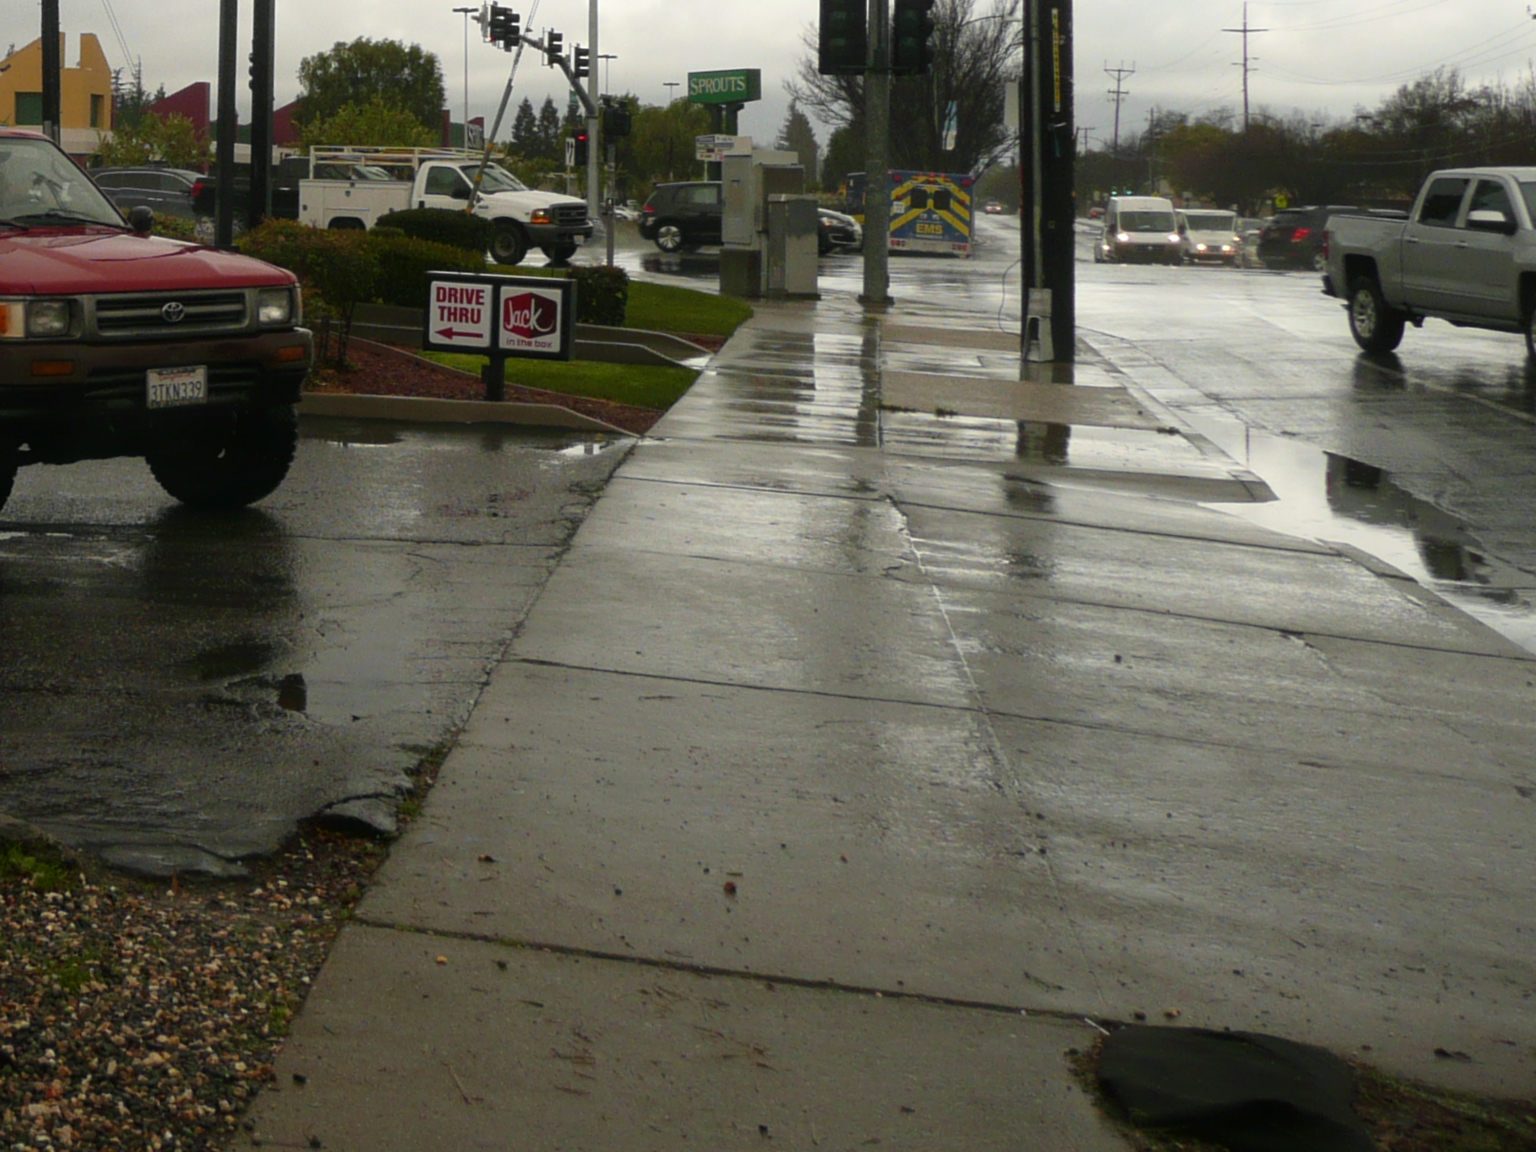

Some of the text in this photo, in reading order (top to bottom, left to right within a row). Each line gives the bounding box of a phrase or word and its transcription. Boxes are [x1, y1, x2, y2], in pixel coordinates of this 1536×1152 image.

[690, 75, 745, 96] SPROUTS
[916, 223, 943, 235] EMS
[435, 286, 485, 306] DRIVE
[438, 305, 482, 325] THRU
[504, 298, 555, 333] Jack
[517, 338, 533, 348] the
[534, 338, 554, 349] box
